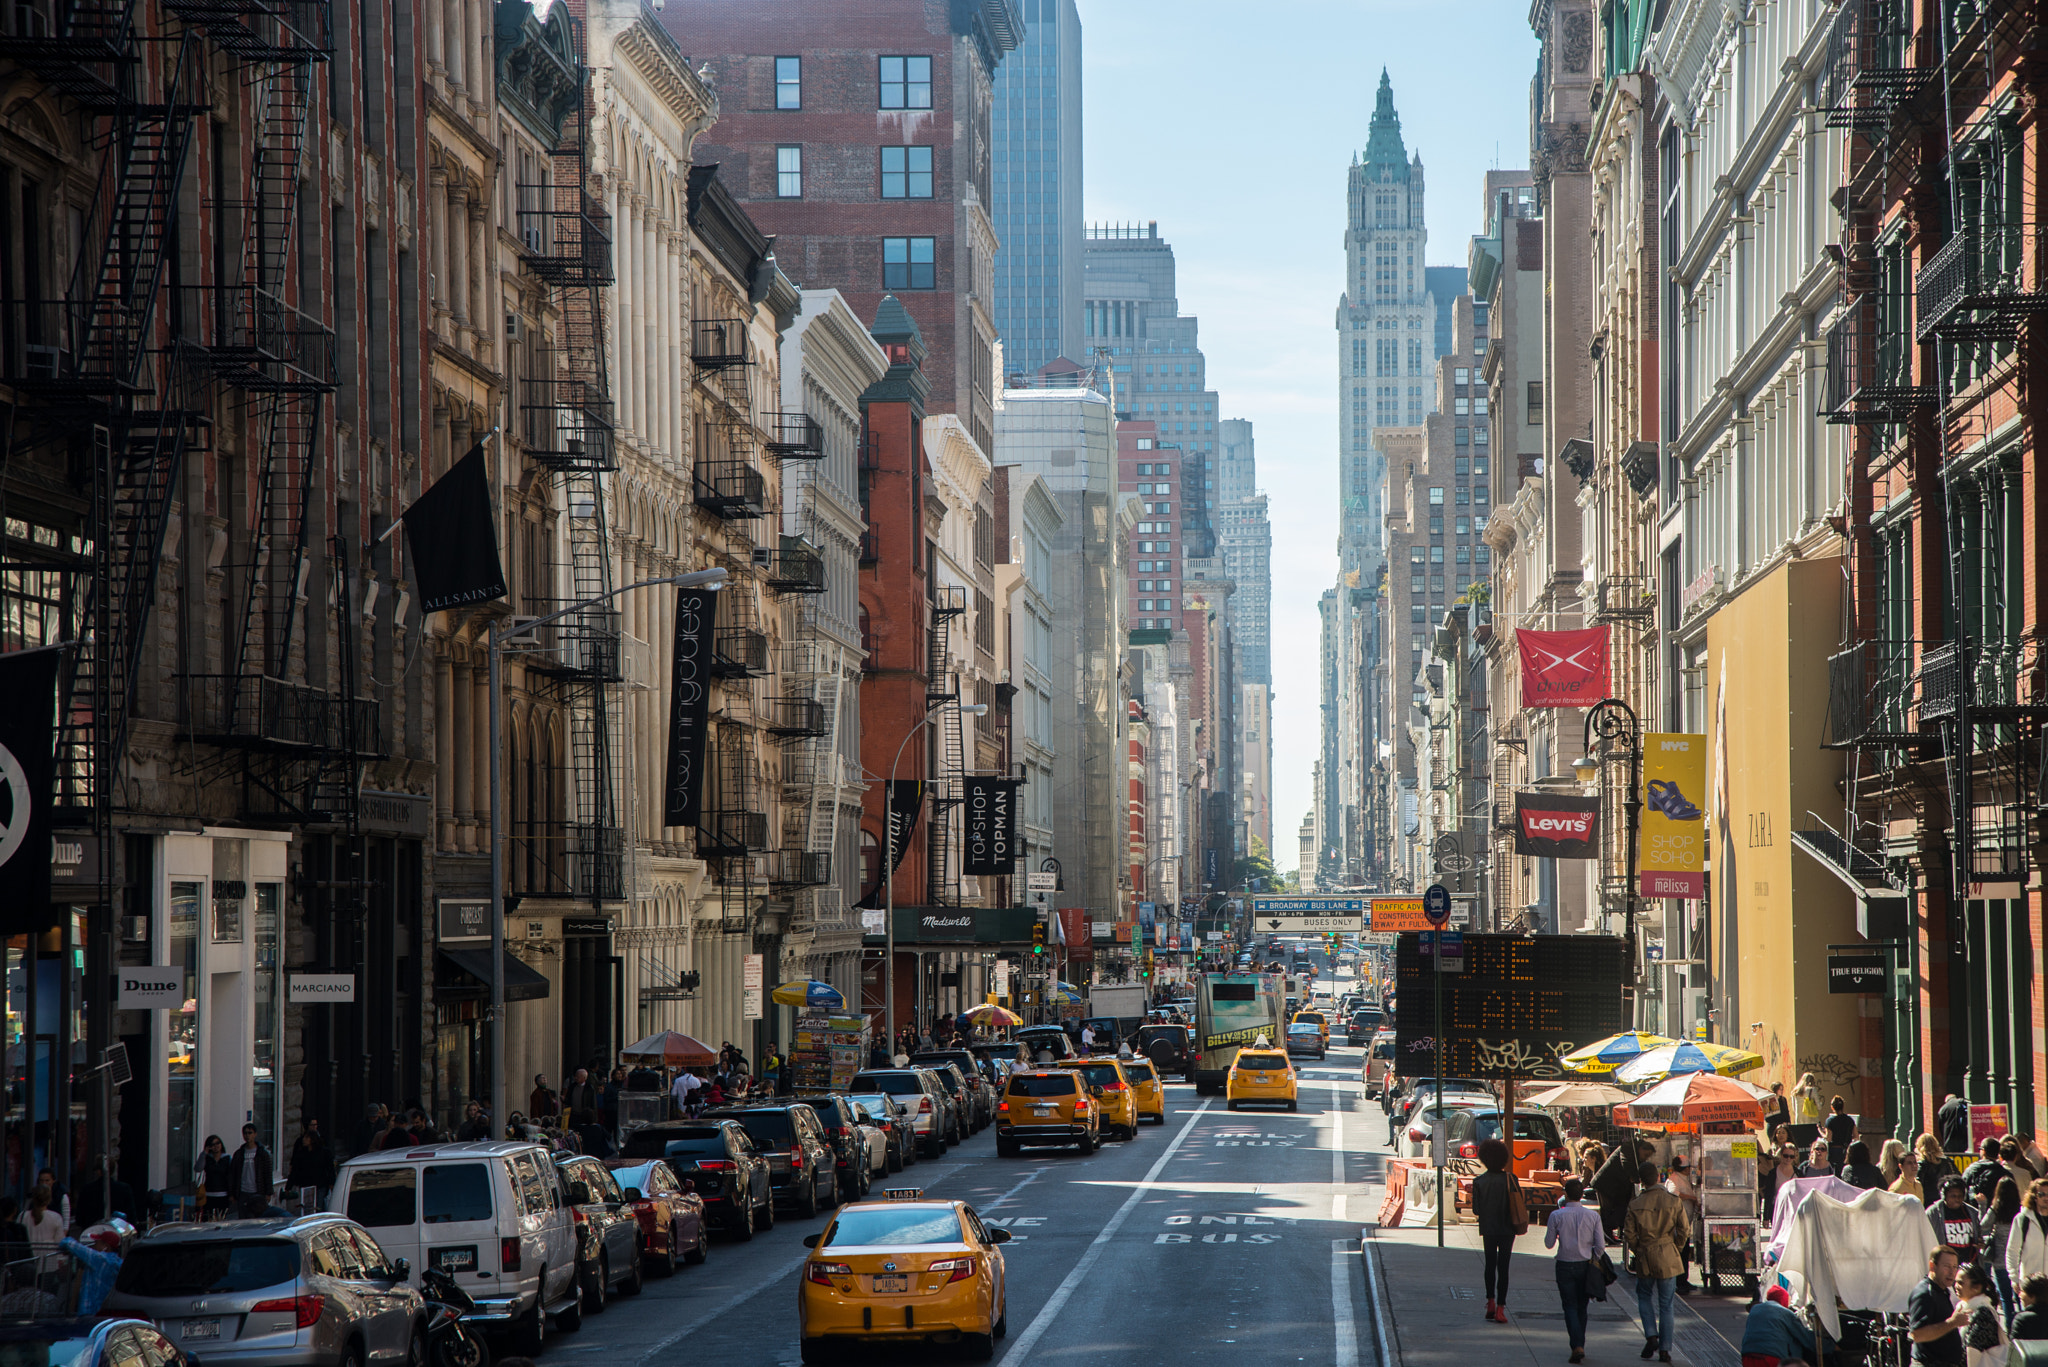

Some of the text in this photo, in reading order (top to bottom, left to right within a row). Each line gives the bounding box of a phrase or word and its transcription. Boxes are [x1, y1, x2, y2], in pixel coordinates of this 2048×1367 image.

[425, 583, 502, 610] ALLSAINTS
[1661, 741, 1689, 751] NYC
[972, 786, 987, 865] TOPSHOP
[994, 791, 1007, 865] TOPMAN
[1749, 812, 1772, 848] ZARA
[1652, 835, 1694, 848] SHOP
[1651, 851, 1695, 864] SOHO
[1655, 880, 1689, 893] melissa
[1379, 908, 1425, 919] CONSTRUCTIO
[922, 916, 971, 928] Madewell
[1420, 945, 1429, 953] M5
[1830, 967, 1884, 976] TRUE RELIGION
[125, 980, 177, 991] Dune
[292, 985, 350, 993] MARCIANO
[1454, 989, 1563, 1031] LANE
[1207, 1032, 1234, 1047] BILLY
[1241, 1025, 1275, 1040] STREET
[1727, 1061, 1753, 1073] SABRETT
[1714, 1104, 1741, 1112] NATURAL
[1688, 1113, 1738, 1121] HONEY-ROASTED
[1163, 1215, 1298, 1225] ONLY
[1153, 1233, 1282, 1244] BUS
